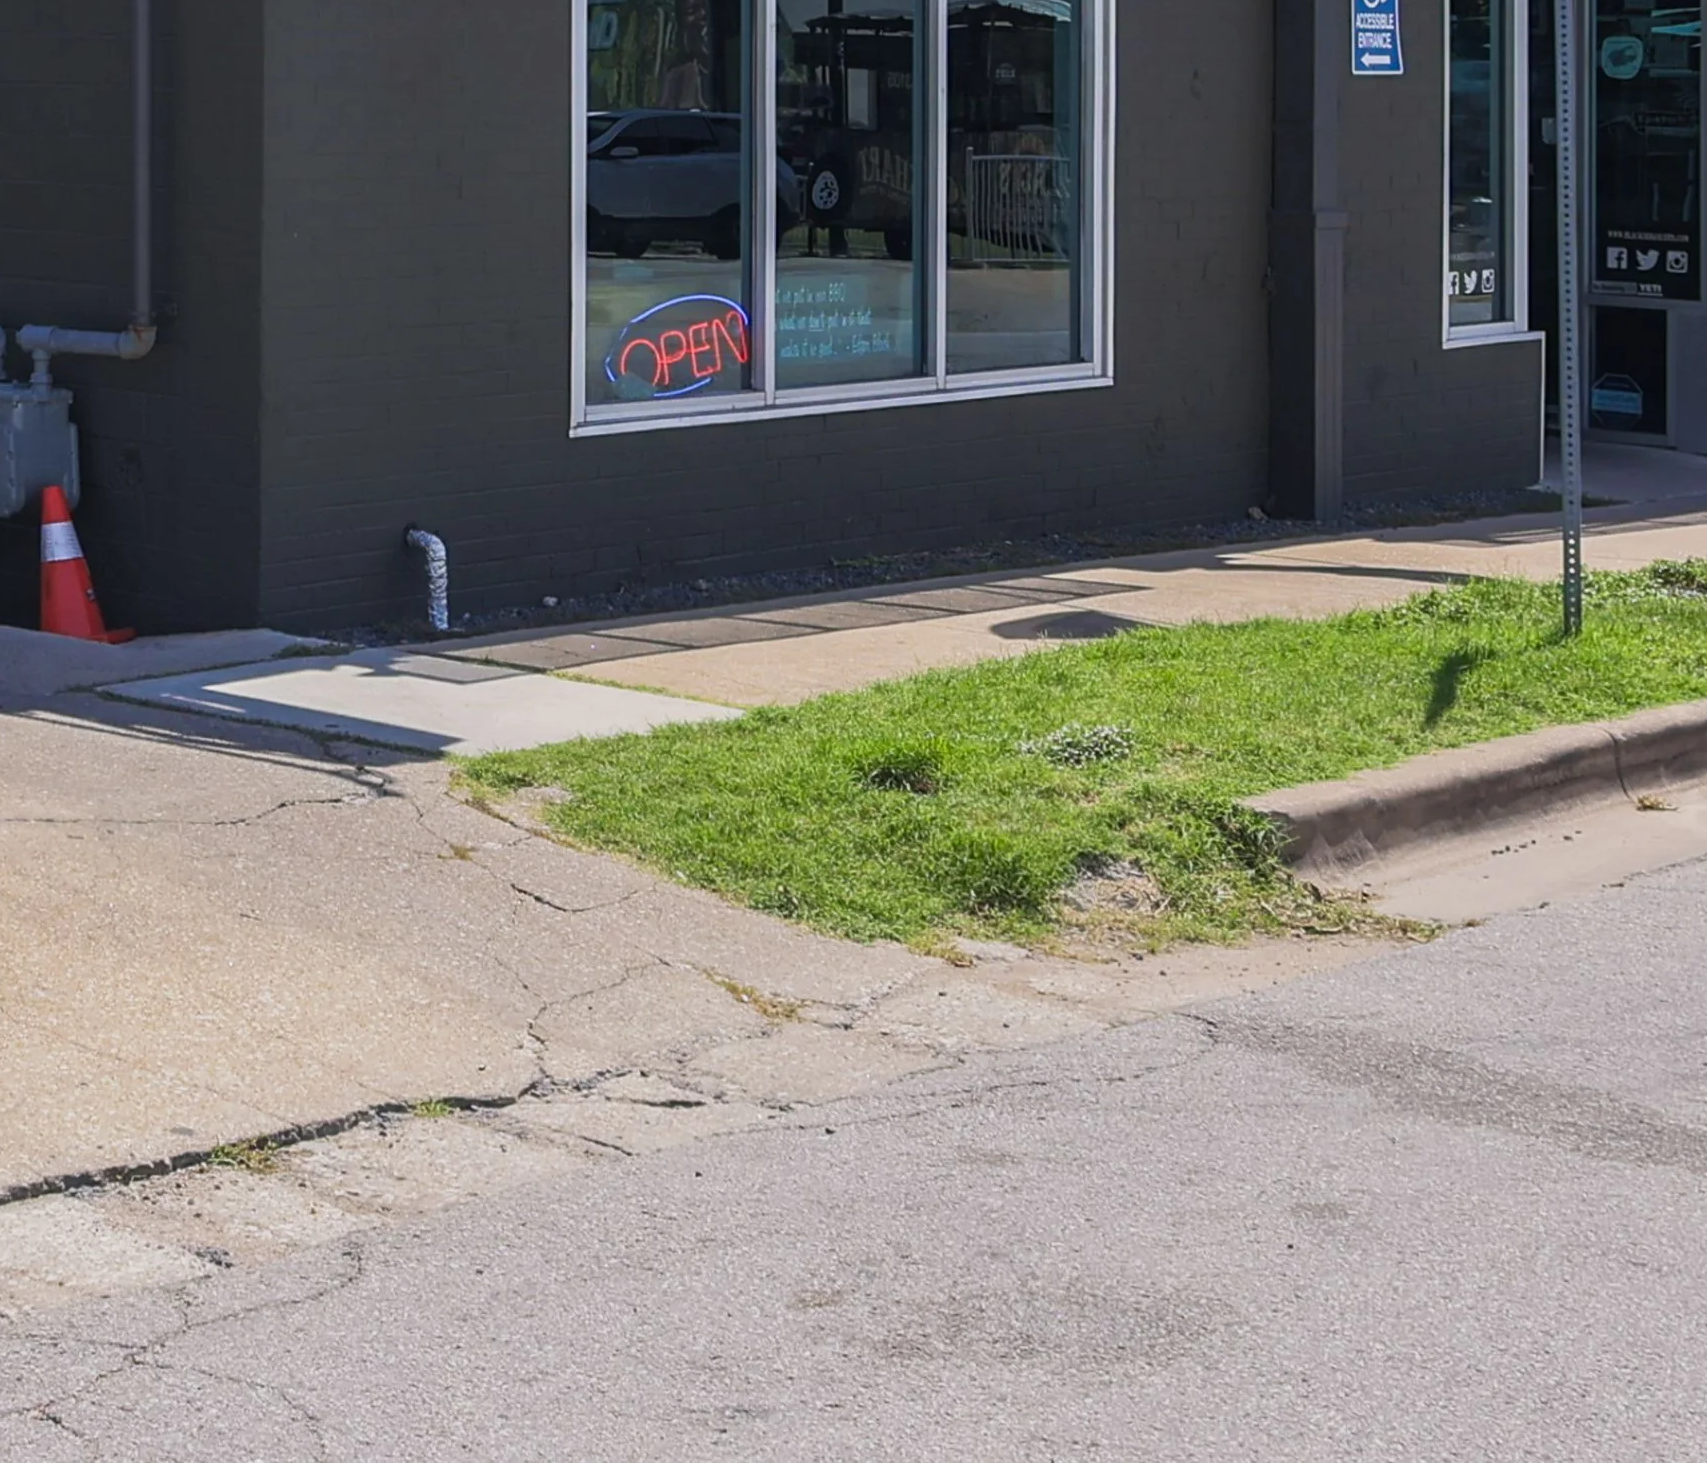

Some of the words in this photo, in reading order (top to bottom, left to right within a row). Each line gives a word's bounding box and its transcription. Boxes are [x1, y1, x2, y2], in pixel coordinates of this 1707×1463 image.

[1355, 13, 1395, 30] ACCESSIBLE
[1358, 32, 1393, 49] ENTRANCE
[620, 310, 748, 386] OPEN
